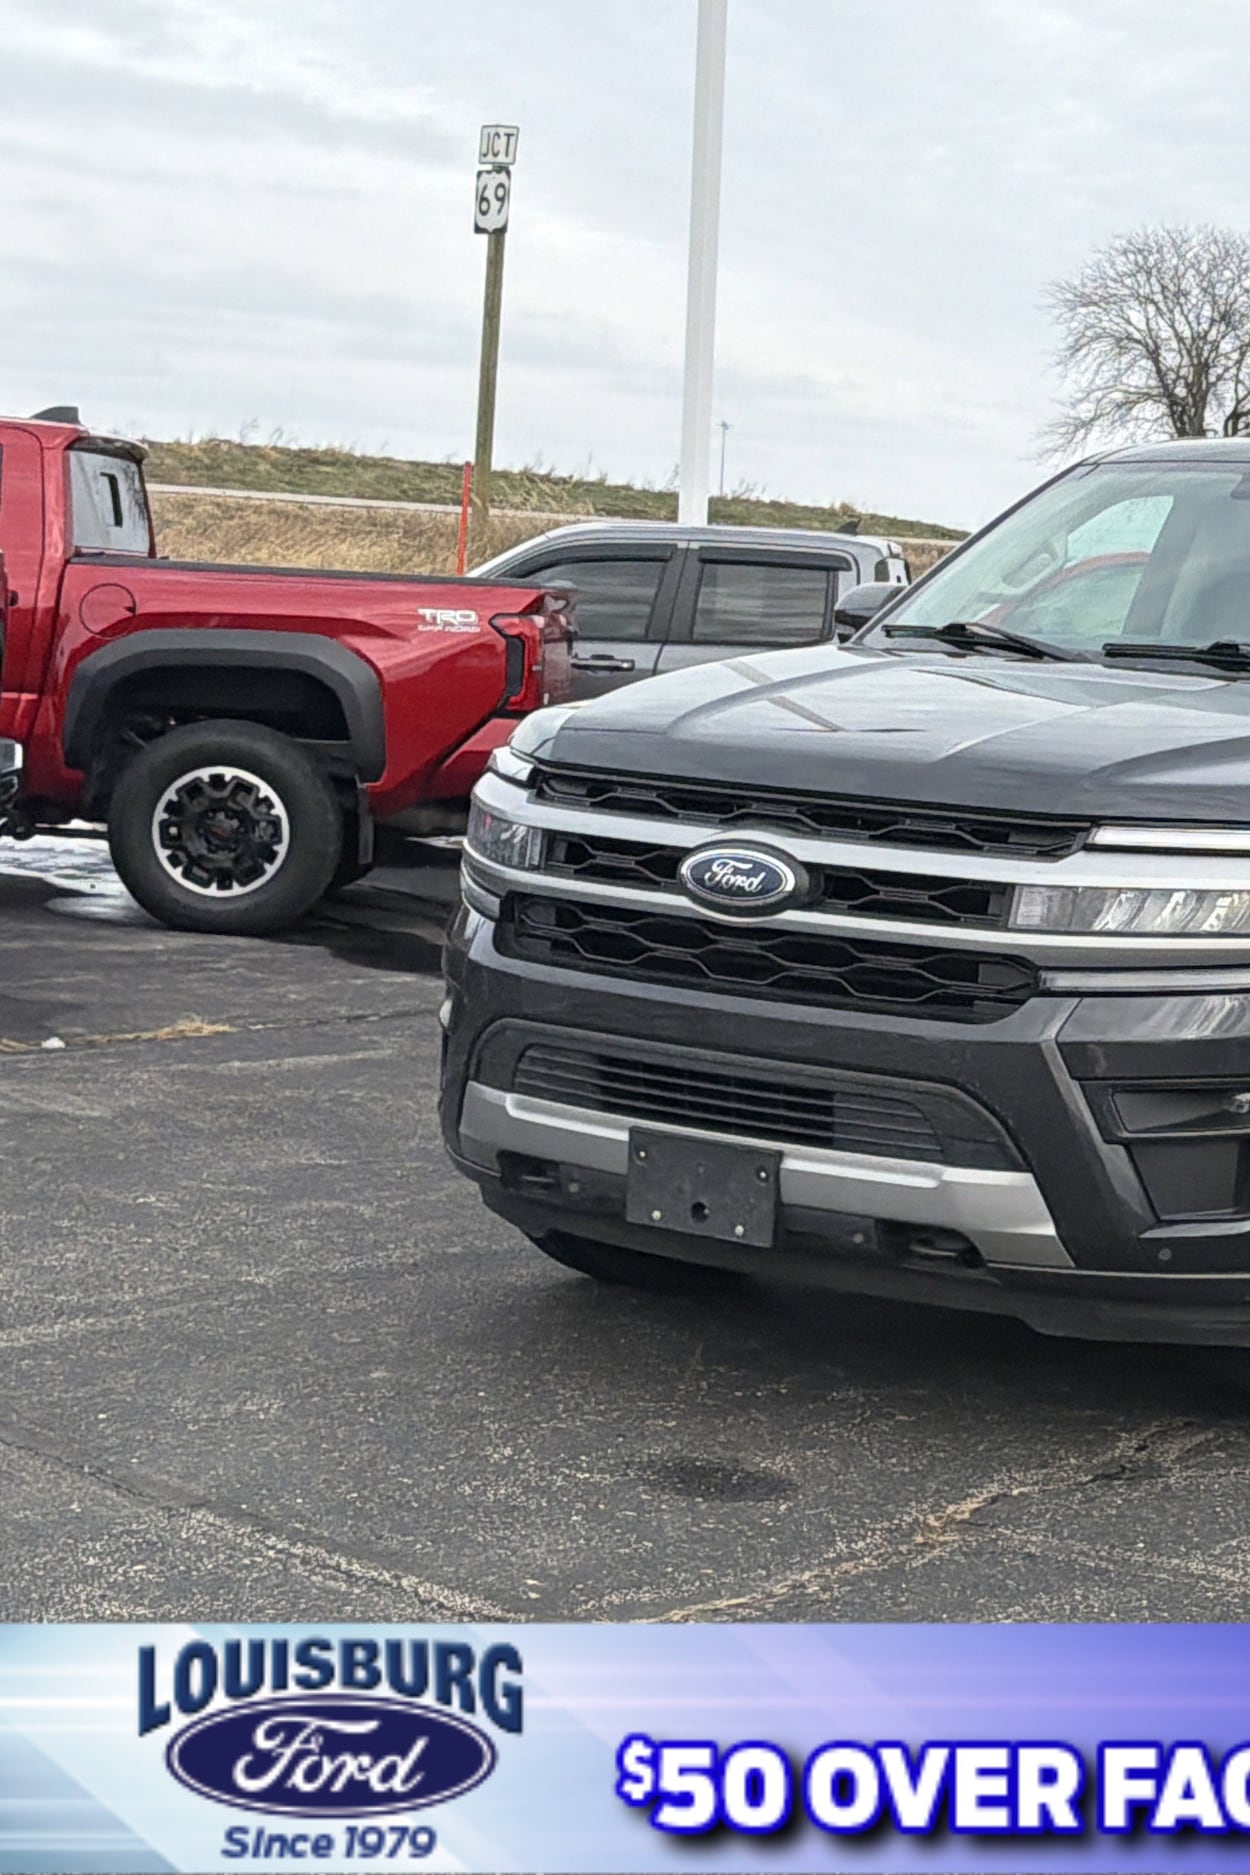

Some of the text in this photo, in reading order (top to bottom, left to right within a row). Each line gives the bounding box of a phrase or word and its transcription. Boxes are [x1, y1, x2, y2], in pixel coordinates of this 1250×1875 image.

[481, 131, 515, 158] JCT
[478, 181, 507, 217] 69
[704, 858, 766, 892] Ford
